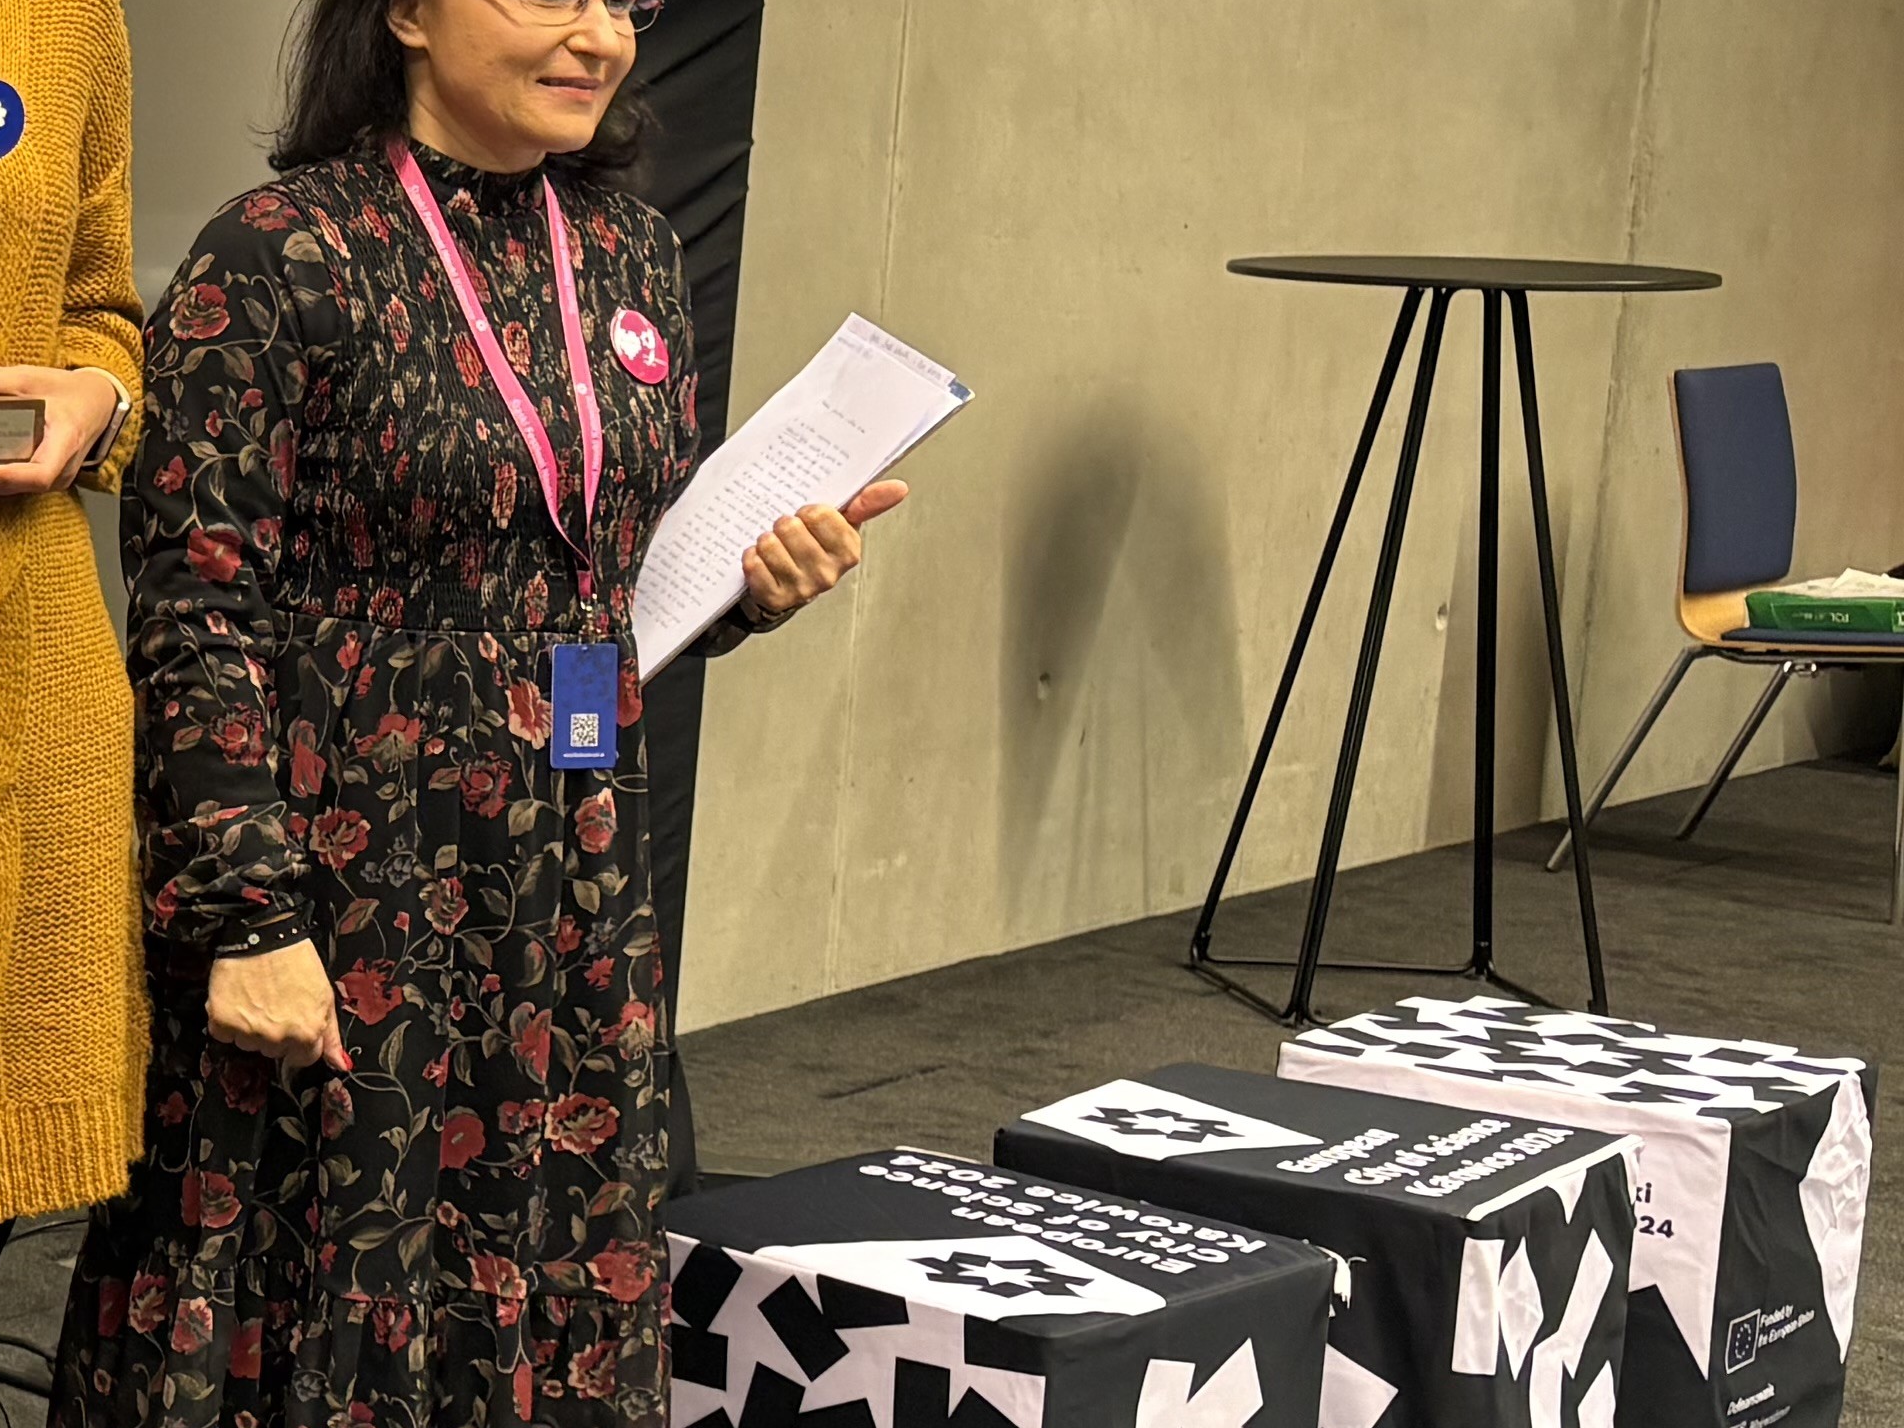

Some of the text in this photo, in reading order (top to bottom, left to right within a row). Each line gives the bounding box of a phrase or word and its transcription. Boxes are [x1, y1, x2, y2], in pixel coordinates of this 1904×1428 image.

[859, 1164, 1046, 1217] Science
[889, 1154, 1267, 1254] Katowice 2024
[951, 1206, 1197, 1274] European
[1115, 1229, 1230, 1263] City
